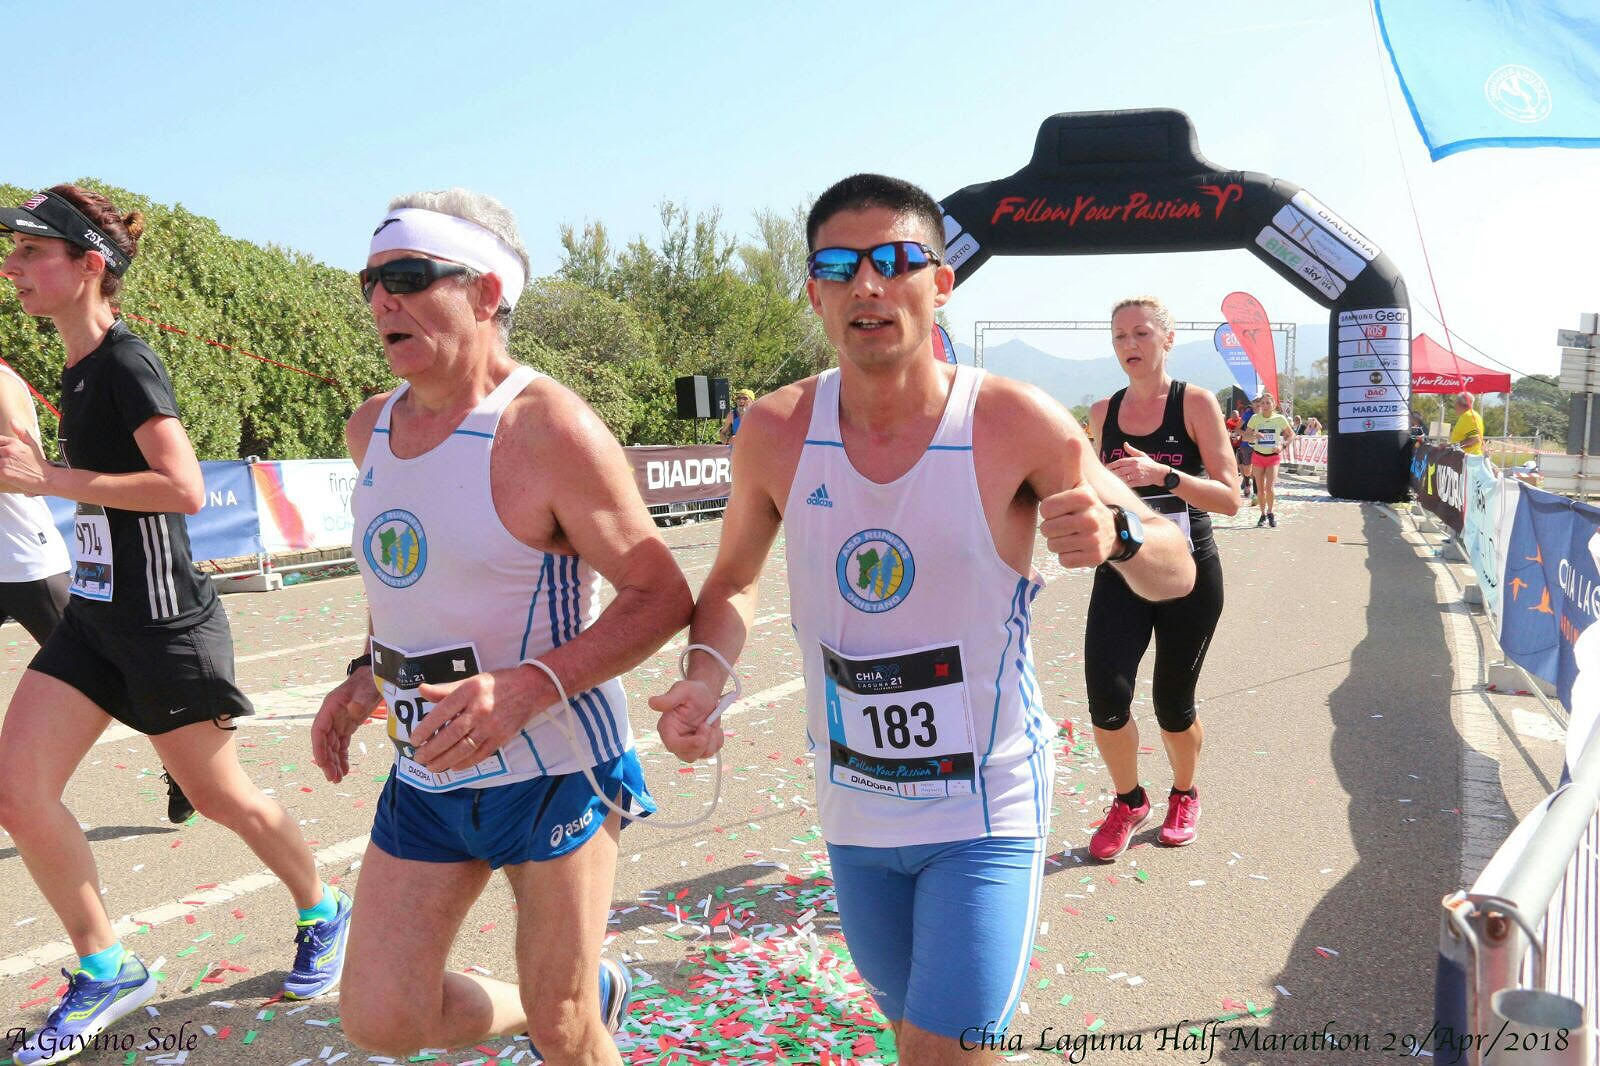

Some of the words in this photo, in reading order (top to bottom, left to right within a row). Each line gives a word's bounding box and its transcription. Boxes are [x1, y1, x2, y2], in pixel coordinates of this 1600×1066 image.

[85, 229, 104, 247] 25X
[1375, 310, 1407, 322] Gear
[646, 457, 732, 490] DIADOR
[75, 522, 103, 556] 974
[864, 531, 911, 560] RUNNERS
[846, 592, 901, 612] ORISTANO
[856, 671, 883, 681] CHIA
[890, 676, 902, 686] 21
[862, 701, 938, 750] 183
[408, 765, 431, 782] DIADORA
[851, 775, 895, 792] DIADORA
[565, 807, 594, 837] asics
